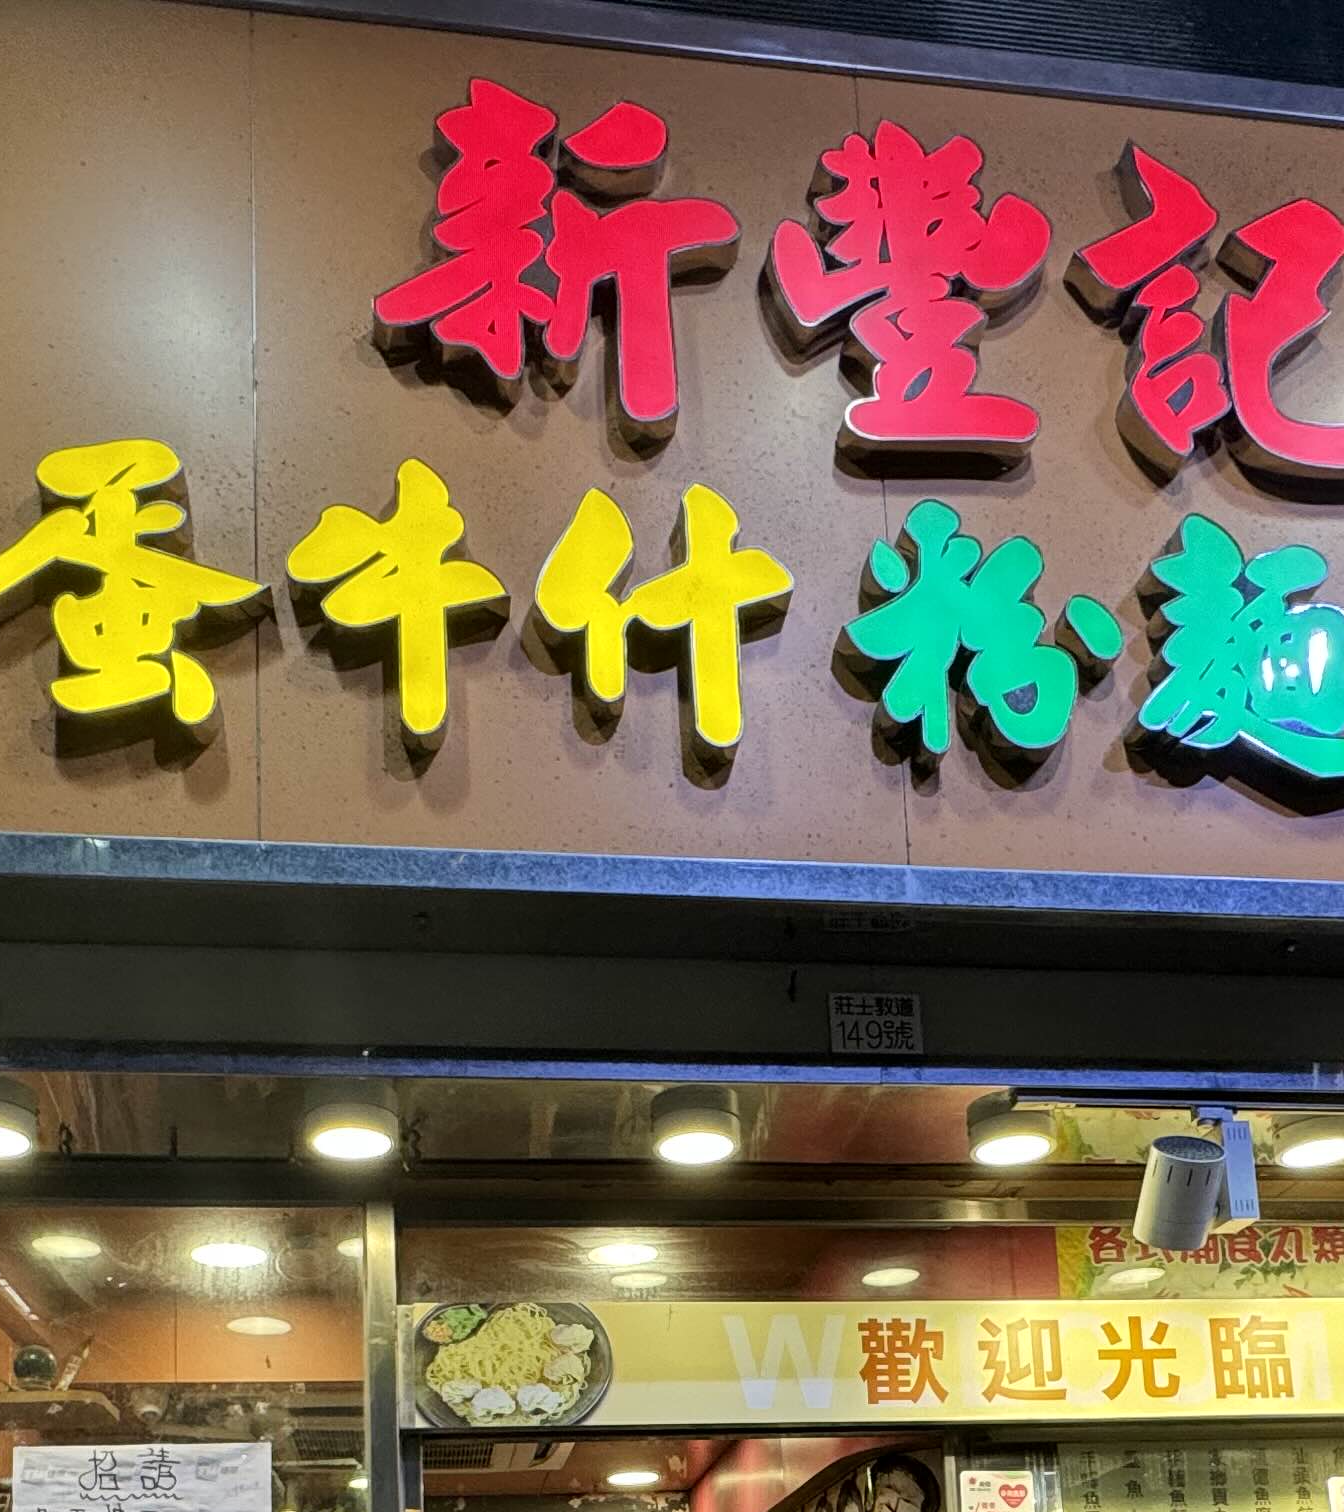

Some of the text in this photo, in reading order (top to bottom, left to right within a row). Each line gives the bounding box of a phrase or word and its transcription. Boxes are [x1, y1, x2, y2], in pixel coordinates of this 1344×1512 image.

[833, 995, 915, 1017] 莊士敦道
[837, 1020, 914, 1050] 149號
[857, 1316, 1296, 1408] 歡迎光臨
